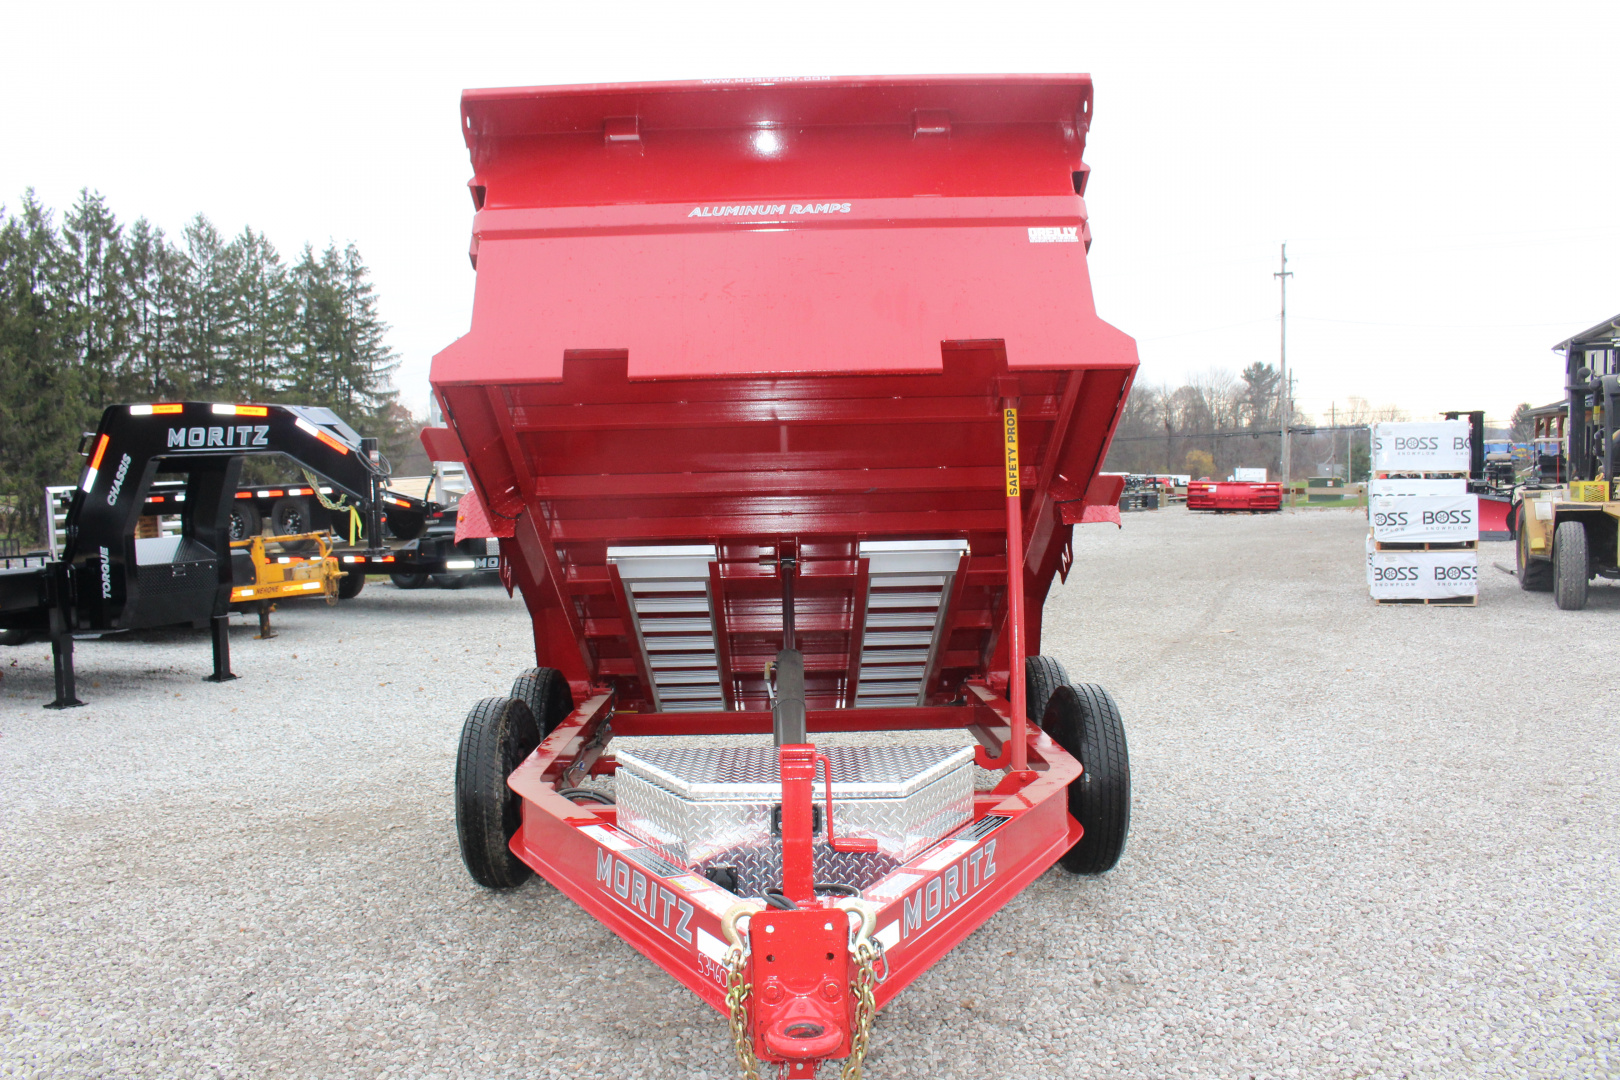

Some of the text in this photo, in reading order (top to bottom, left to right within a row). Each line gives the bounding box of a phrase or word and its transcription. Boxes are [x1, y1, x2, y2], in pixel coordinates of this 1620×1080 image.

[688, 203, 852, 218] ALUMINUM RAMPS
[167, 425, 270, 448] MORITZ
[1395, 437, 1439, 451] BOSS
[1006, 409, 1018, 496] SAFETY PROP
[107, 453, 132, 507] CHASSIS
[1422, 510, 1472, 525] BOSS
[100, 546, 112, 599] TORQUE
[475, 557, 499, 569] MO
[1374, 567, 1419, 581] BOSS
[597, 847, 694, 944] MORITZ
[903, 838, 996, 939] MORITZ
